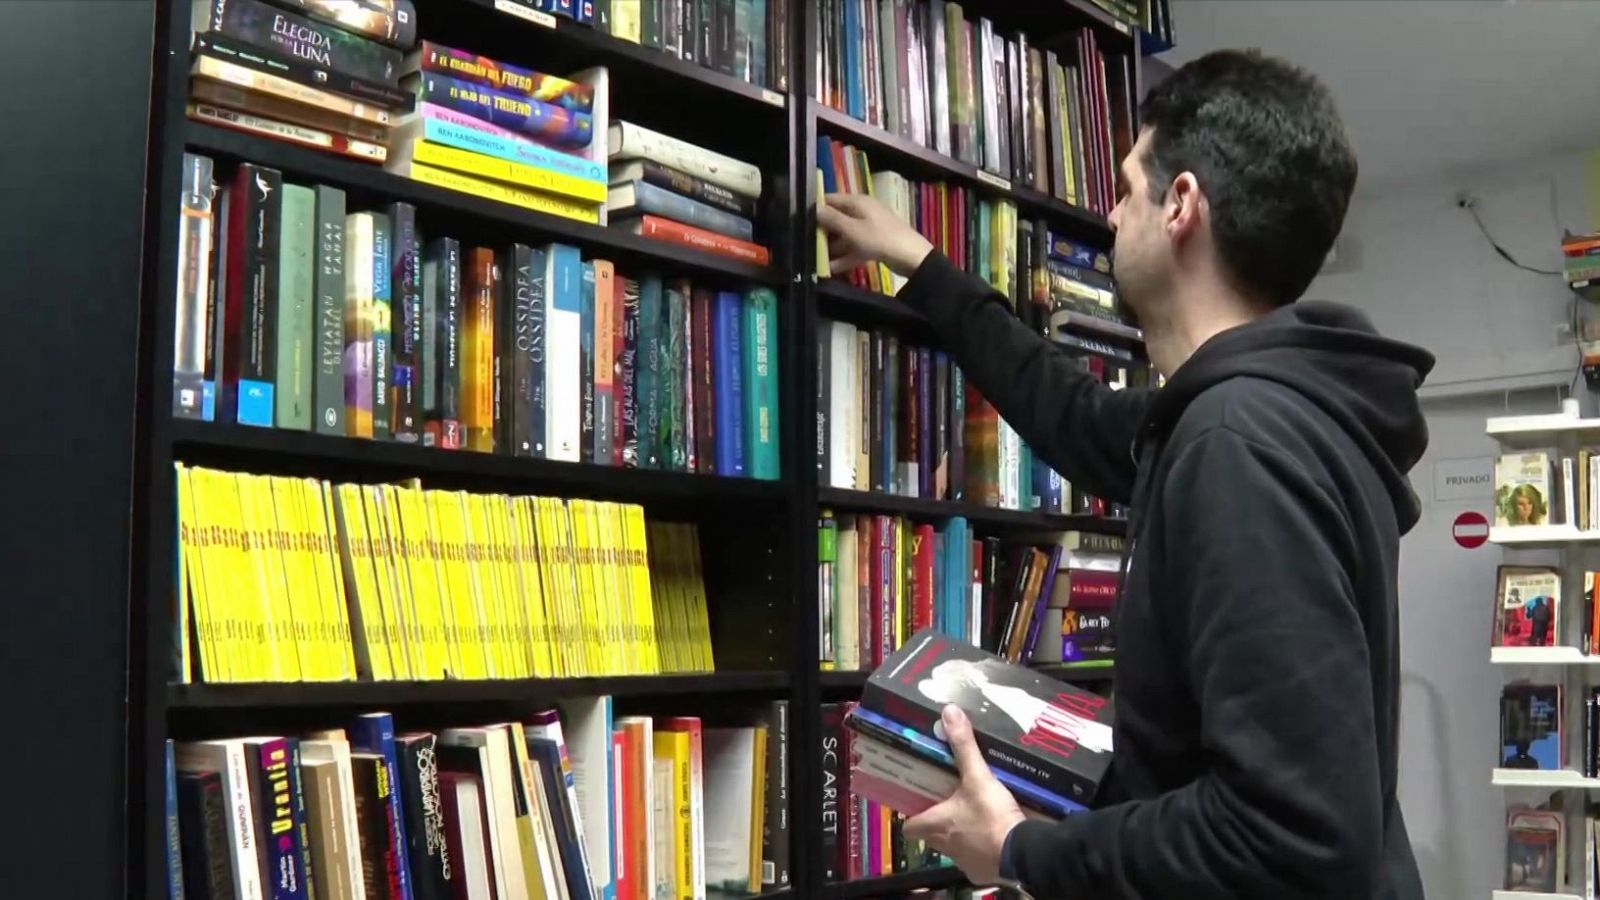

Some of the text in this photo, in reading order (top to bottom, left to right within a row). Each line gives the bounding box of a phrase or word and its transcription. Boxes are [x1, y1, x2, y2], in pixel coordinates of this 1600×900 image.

[292, 42, 331, 67] LUNA
[501, 71, 532, 92] FUEGO
[493, 95, 532, 117] TRUENO
[516, 264, 530, 351] OSSIDEA
[530, 276, 544, 363] OSSIDEA
[375, 339, 386, 405] DAVID BALDACCI
[1445, 473, 1490, 485] PRIVADO
[416, 747, 435, 816] VAMPIROS
